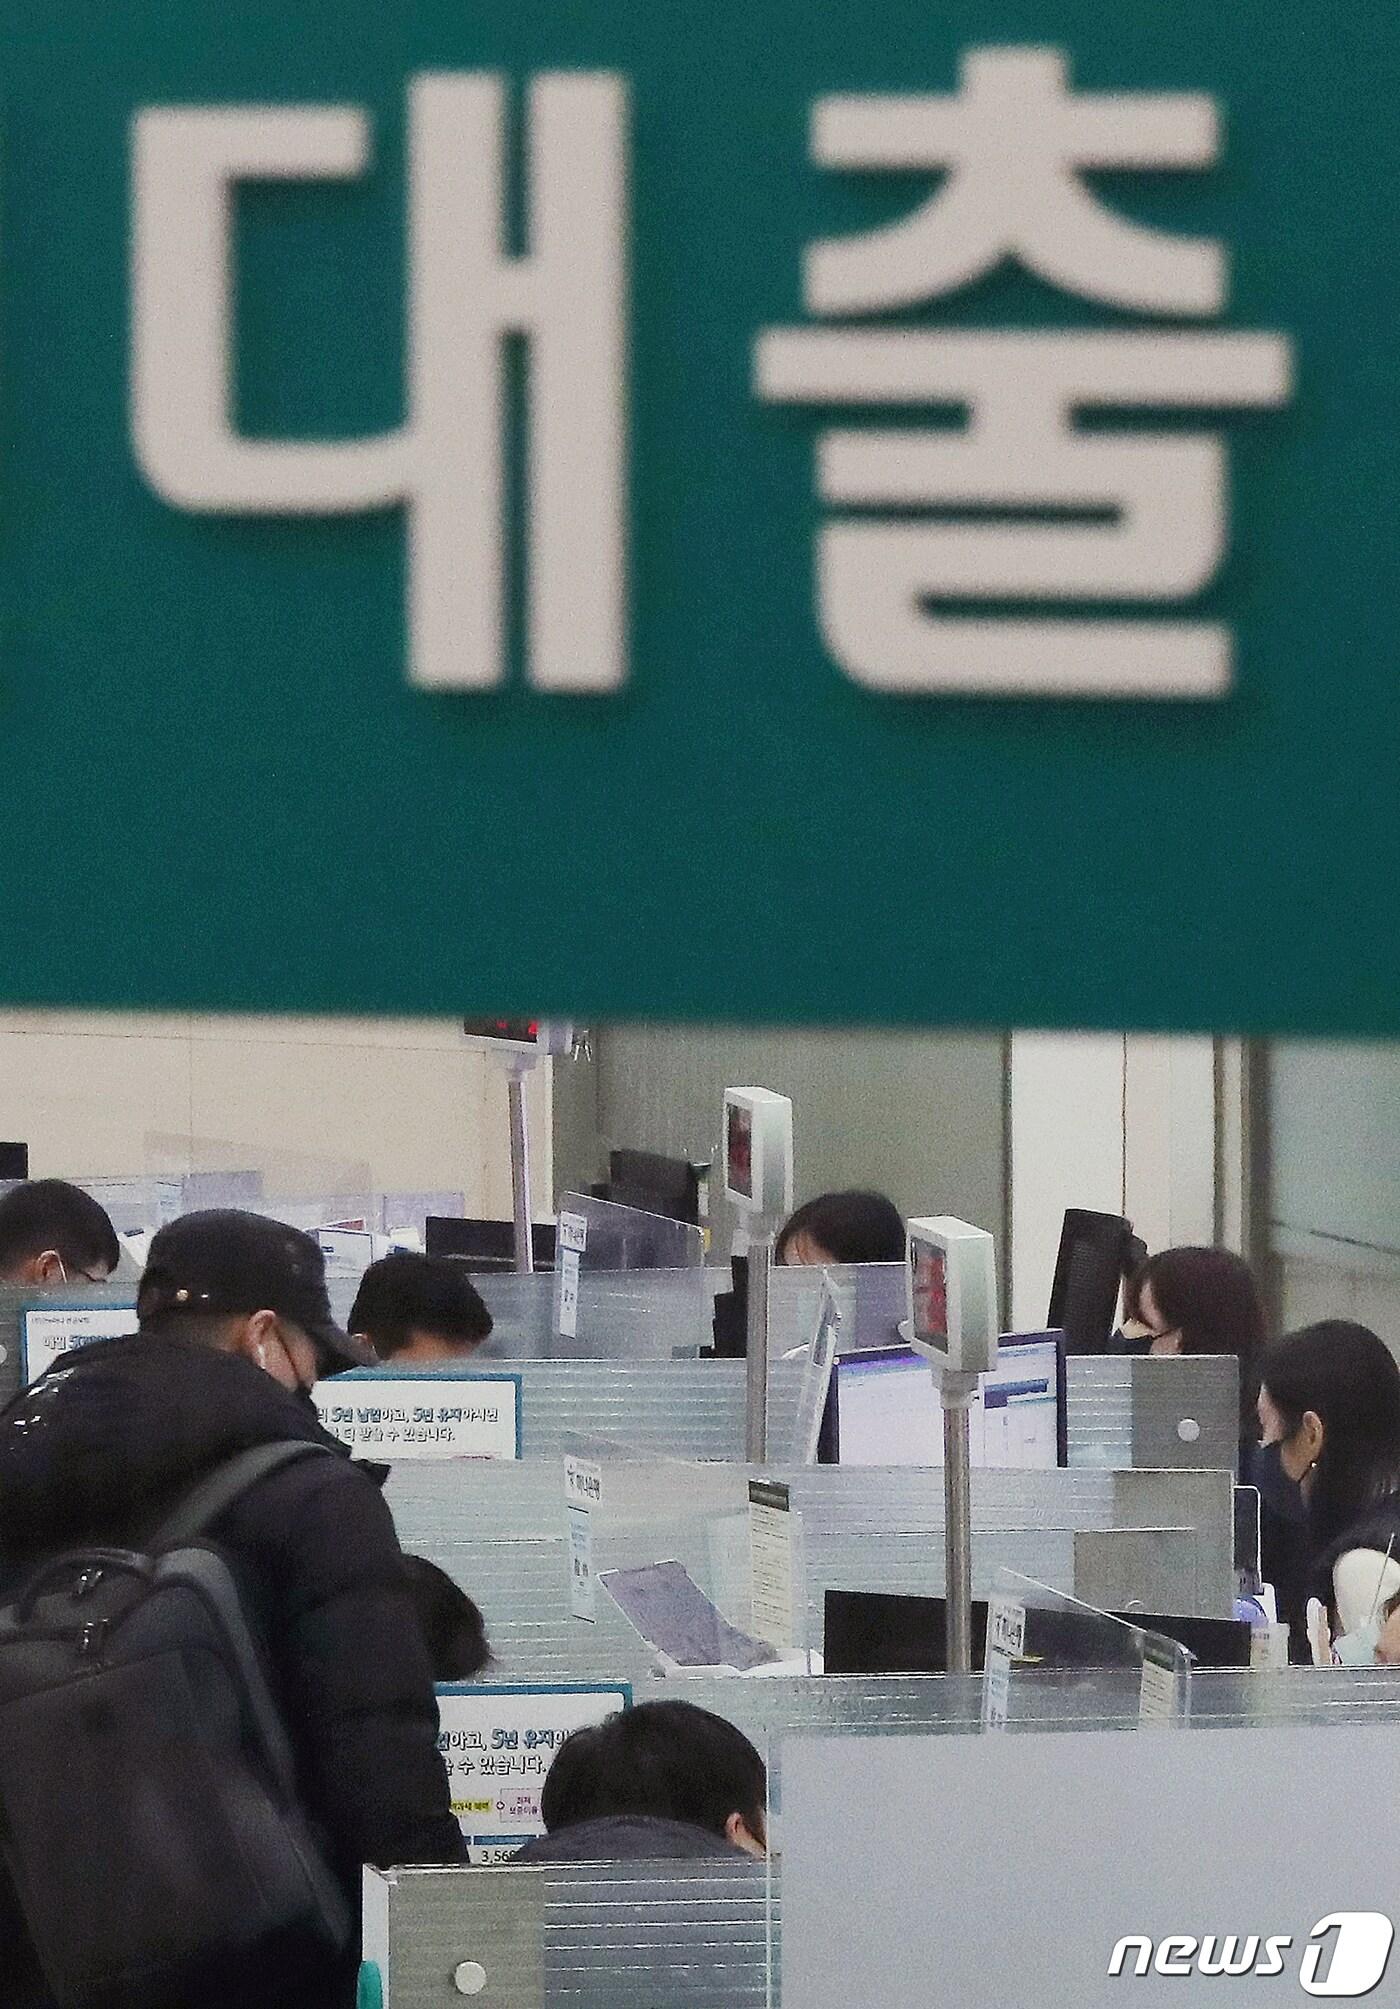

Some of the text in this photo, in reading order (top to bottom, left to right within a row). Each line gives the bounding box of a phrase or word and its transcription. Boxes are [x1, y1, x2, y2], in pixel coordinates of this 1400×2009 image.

[131, 45, 1292, 697] 대출
[491, 1729, 519, 1750] 5년
[458, 1757, 476, 1775] 수
[480, 1755, 547, 1776] 있습니다.
